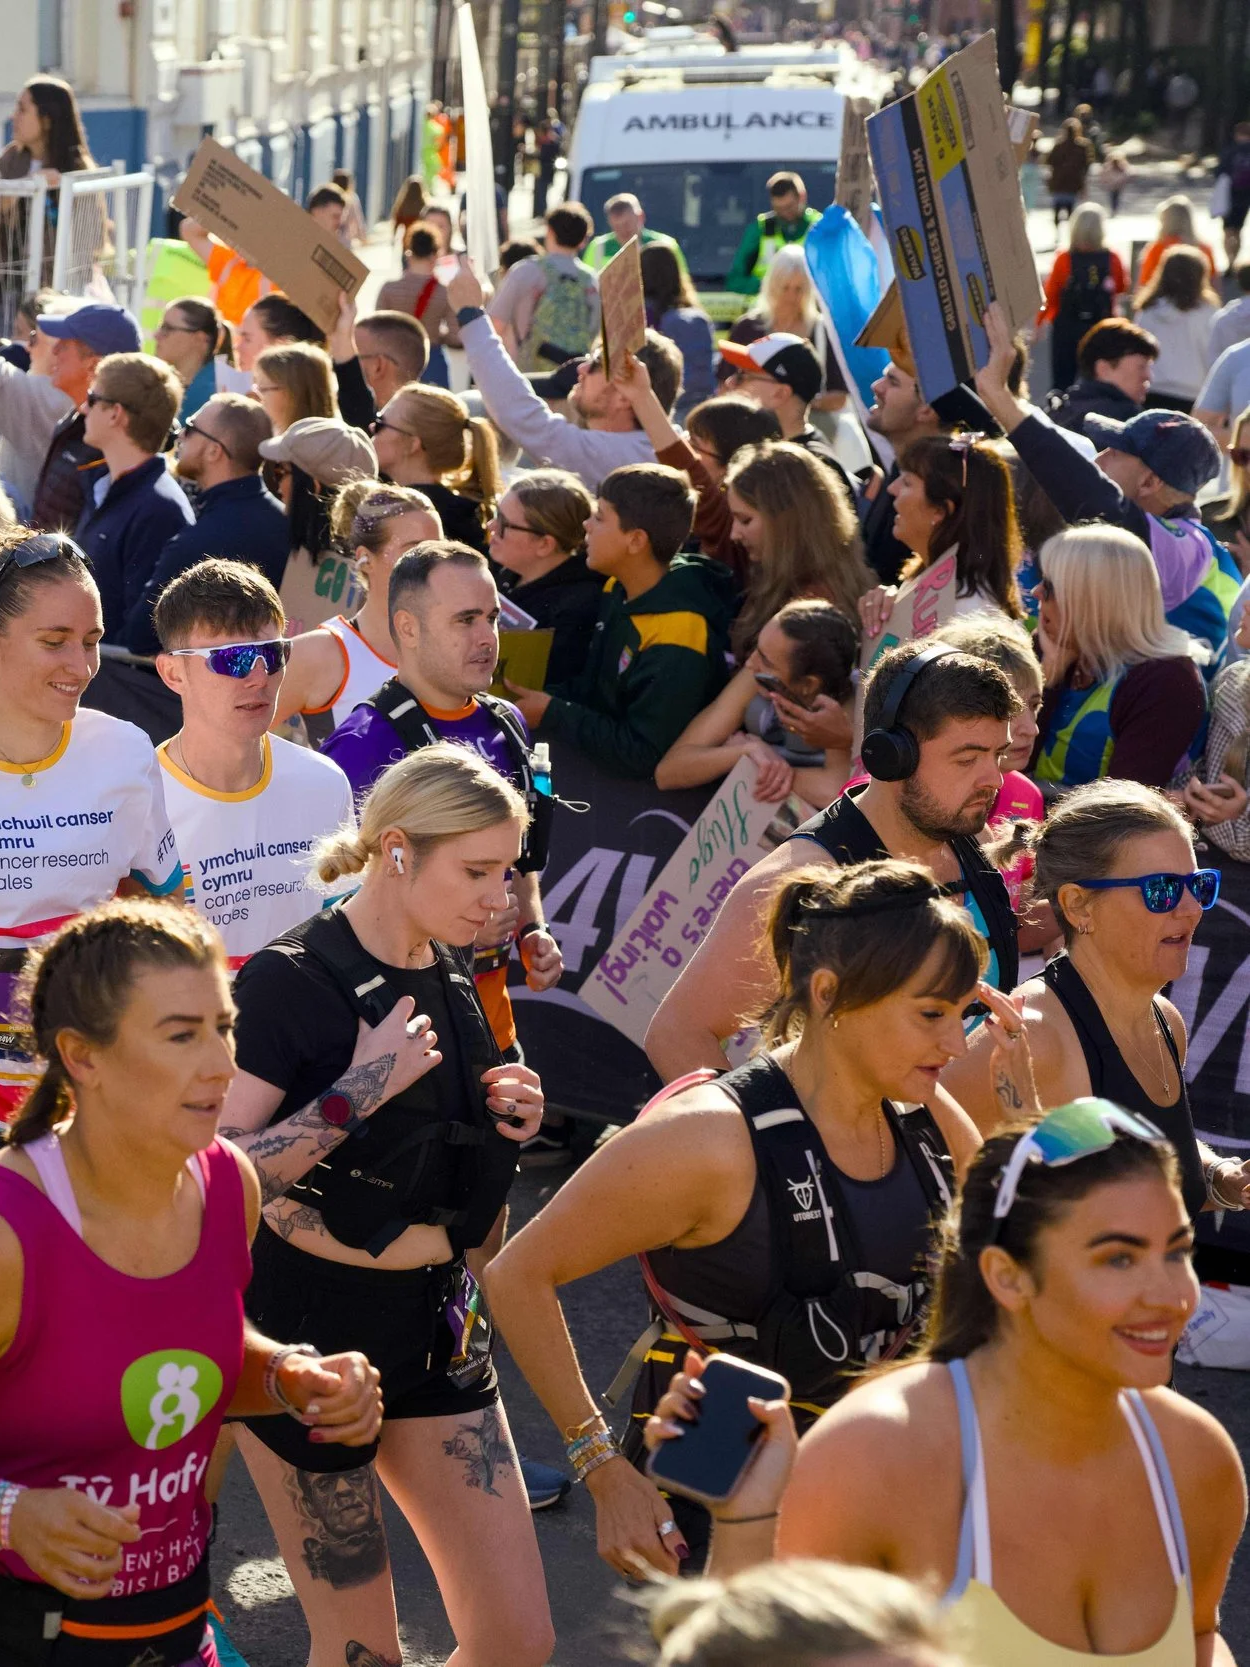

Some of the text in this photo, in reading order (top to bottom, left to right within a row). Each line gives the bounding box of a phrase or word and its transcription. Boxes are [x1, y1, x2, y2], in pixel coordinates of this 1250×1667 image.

[623, 112, 835, 132] AMBULANCE
[927, 96, 942, 144] PACK
[912, 147, 926, 176] JAM
[917, 177, 934, 217] CHILLI
[900, 226, 923, 280] WALKERS
[927, 229, 946, 278] CHEESE
[937, 279, 957, 331] GRILLED
[55, 810, 114, 828] canser
[41, 849, 109, 868] research
[267, 839, 314, 858] canser
[201, 868, 253, 892] cymru
[596, 780, 753, 1006] Hugo waiting!
[661, 946, 682, 969] a
[792, 1210, 822, 1222] UTOBEST
